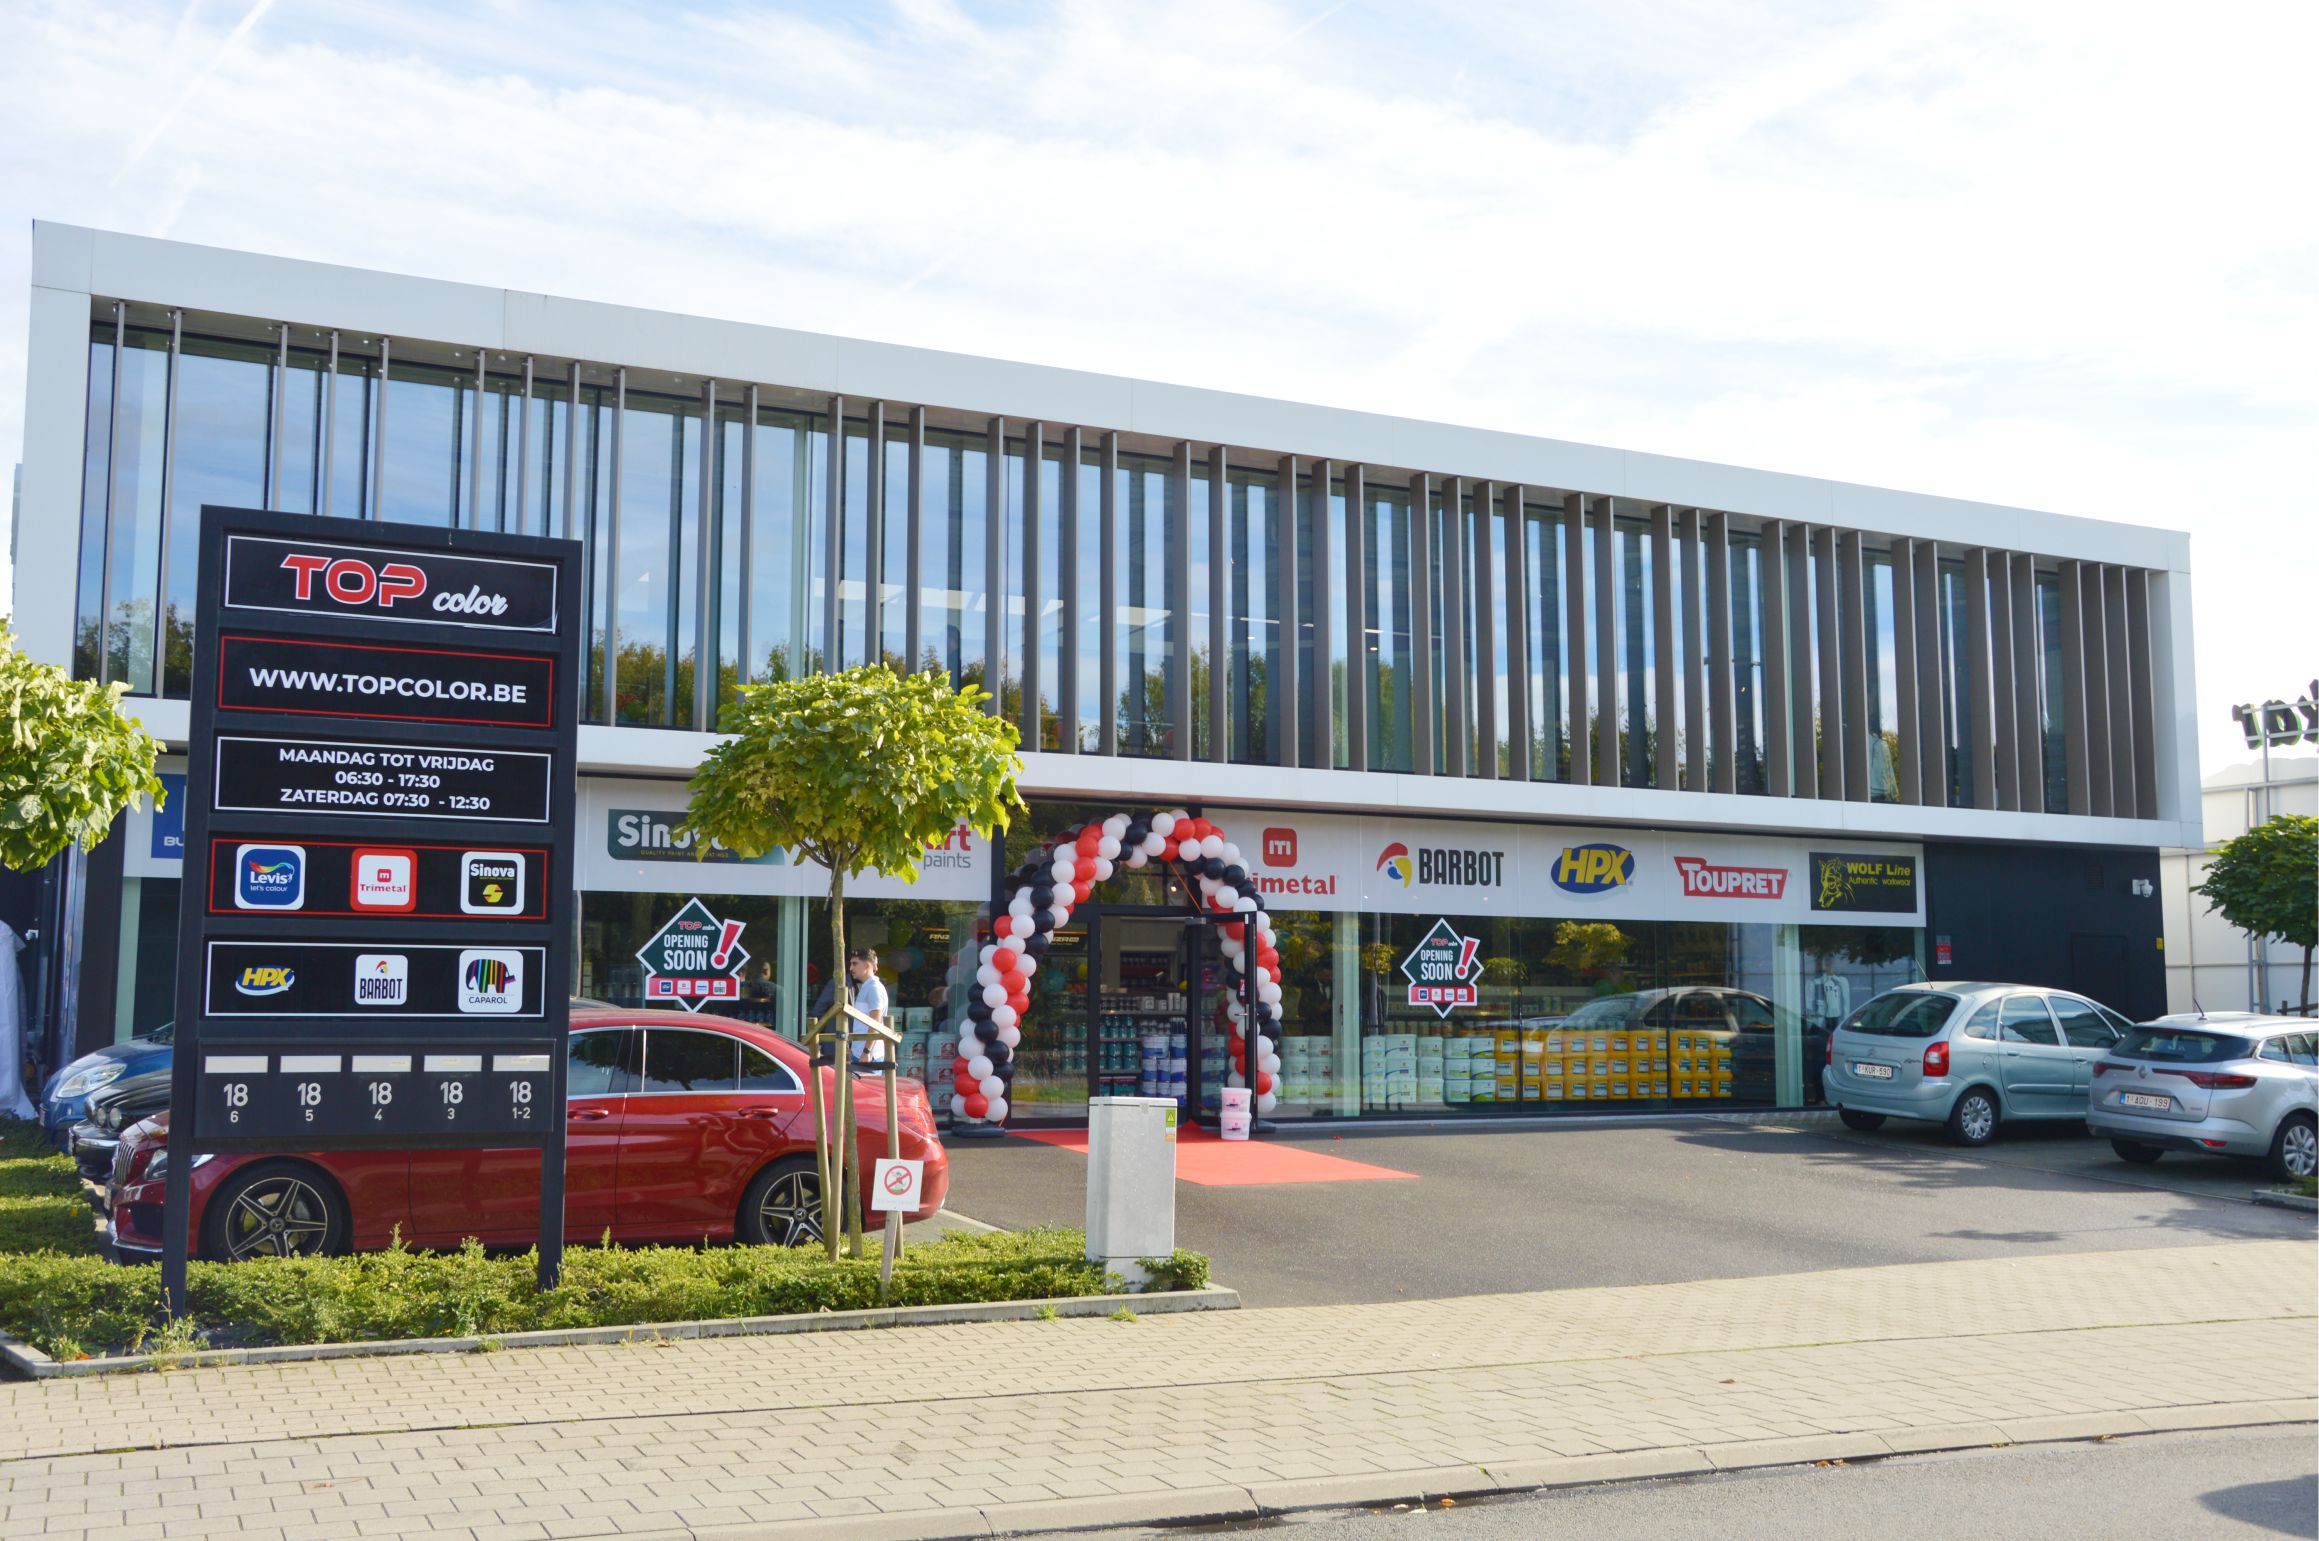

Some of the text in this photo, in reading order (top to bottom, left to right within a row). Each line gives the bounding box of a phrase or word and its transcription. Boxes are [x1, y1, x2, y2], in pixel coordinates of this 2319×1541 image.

[279, 553, 508, 616] TOP color
[249, 667, 527, 704] WWW.TOPCOLOR.BE
[279, 748, 495, 772] MAANDAG TOT VRIJDAG
[335, 770, 383, 786] 06:30
[398, 773, 441, 789] 17:30
[280, 788, 379, 807] ZATERDAG
[383, 792, 430, 808] 07:30
[449, 795, 491, 811] 12:30
[470, 863, 515, 878] Sinova
[924, 852, 971, 870] paints
[1418, 848, 1504, 887] BARBOT
[1558, 848, 1631, 886] HPX
[1847, 862, 1911, 876] WOLF Line
[250, 871, 288, 884] Levis
[1681, 863, 1783, 894] TOUPRET
[360, 884, 406, 893] Trimetal
[663, 934, 709, 948] OPENING
[663, 950, 707, 971] SOON
[1420, 949, 1453, 962] OPENING
[242, 967, 291, 987] HPX
[1421, 963, 1453, 981] SOON
[359, 978, 403, 1000] BARBOT
[468, 996, 508, 1004] CAPAROL
[223, 1083, 248, 1107] 18
[297, 1082, 321, 1106] 18
[368, 1082, 393, 1105] 18
[440, 1081, 463, 1104] 18
[509, 1081, 532, 1103] 18
[230, 1111, 239, 1123] 6
[305, 1109, 314, 1122] 5
[374, 1108, 383, 1121] 4
[447, 1108, 455, 1120] 3
[512, 1107, 531, 1119] 1-2
